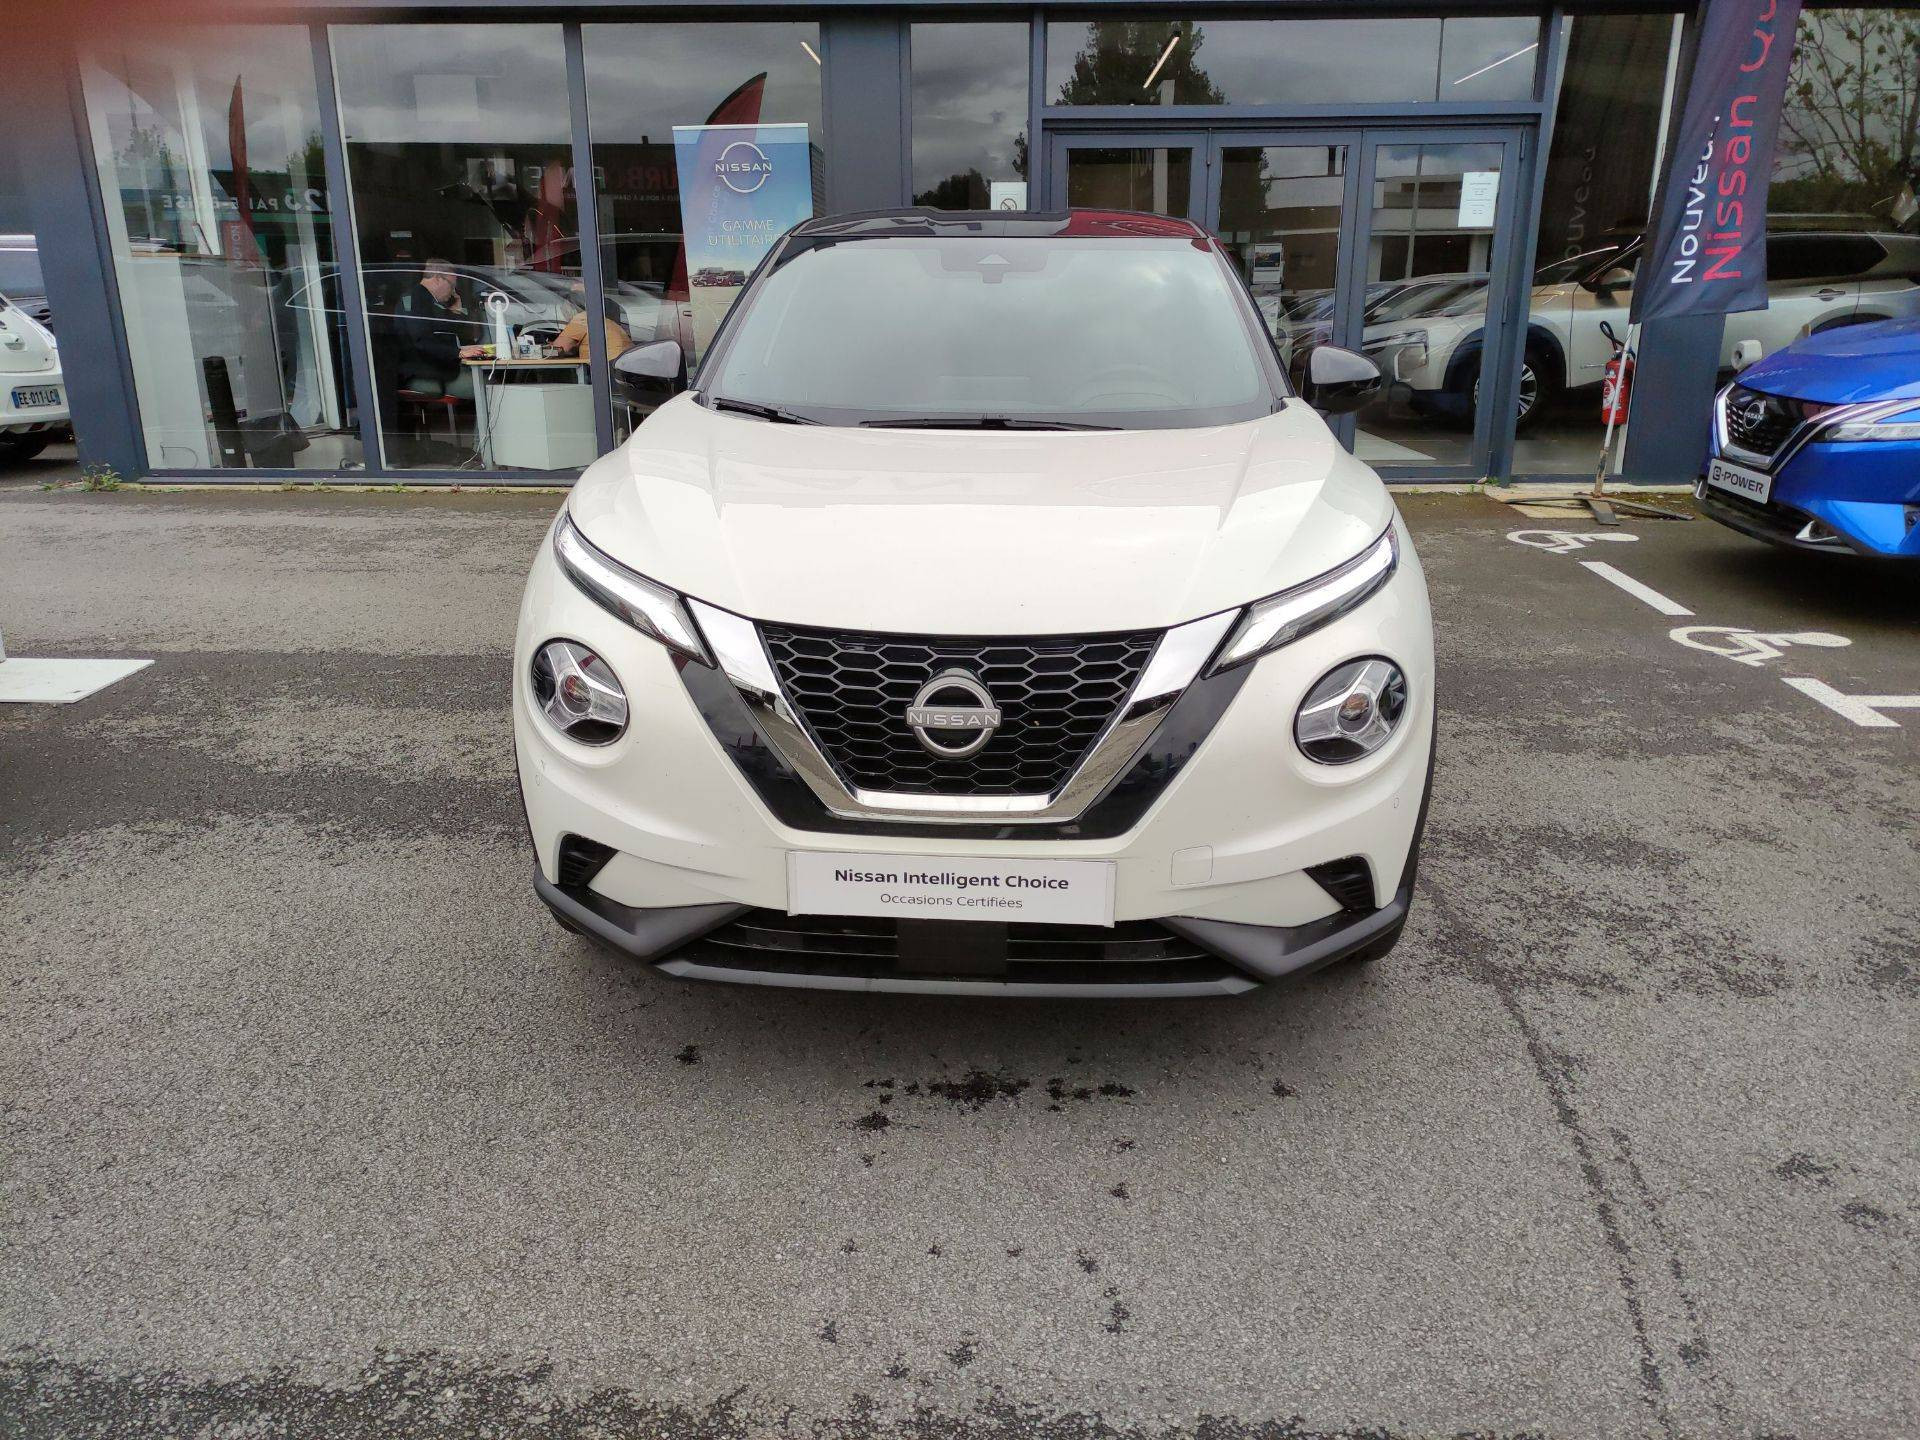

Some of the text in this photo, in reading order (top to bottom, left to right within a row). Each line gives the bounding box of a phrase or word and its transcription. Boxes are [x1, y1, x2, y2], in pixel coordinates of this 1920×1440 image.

[715, 162, 773, 173] NISSAN
[1703, 95, 1757, 281] Nissan
[722, 219, 775, 232] GAMME
[708, 232, 782, 247] UTILITAIR
[908, 711, 999, 726] NISSAN
[834, 868, 1070, 890] Nissan Intelligent Choice
[880, 893, 1023, 909] Occasions Certifiées
